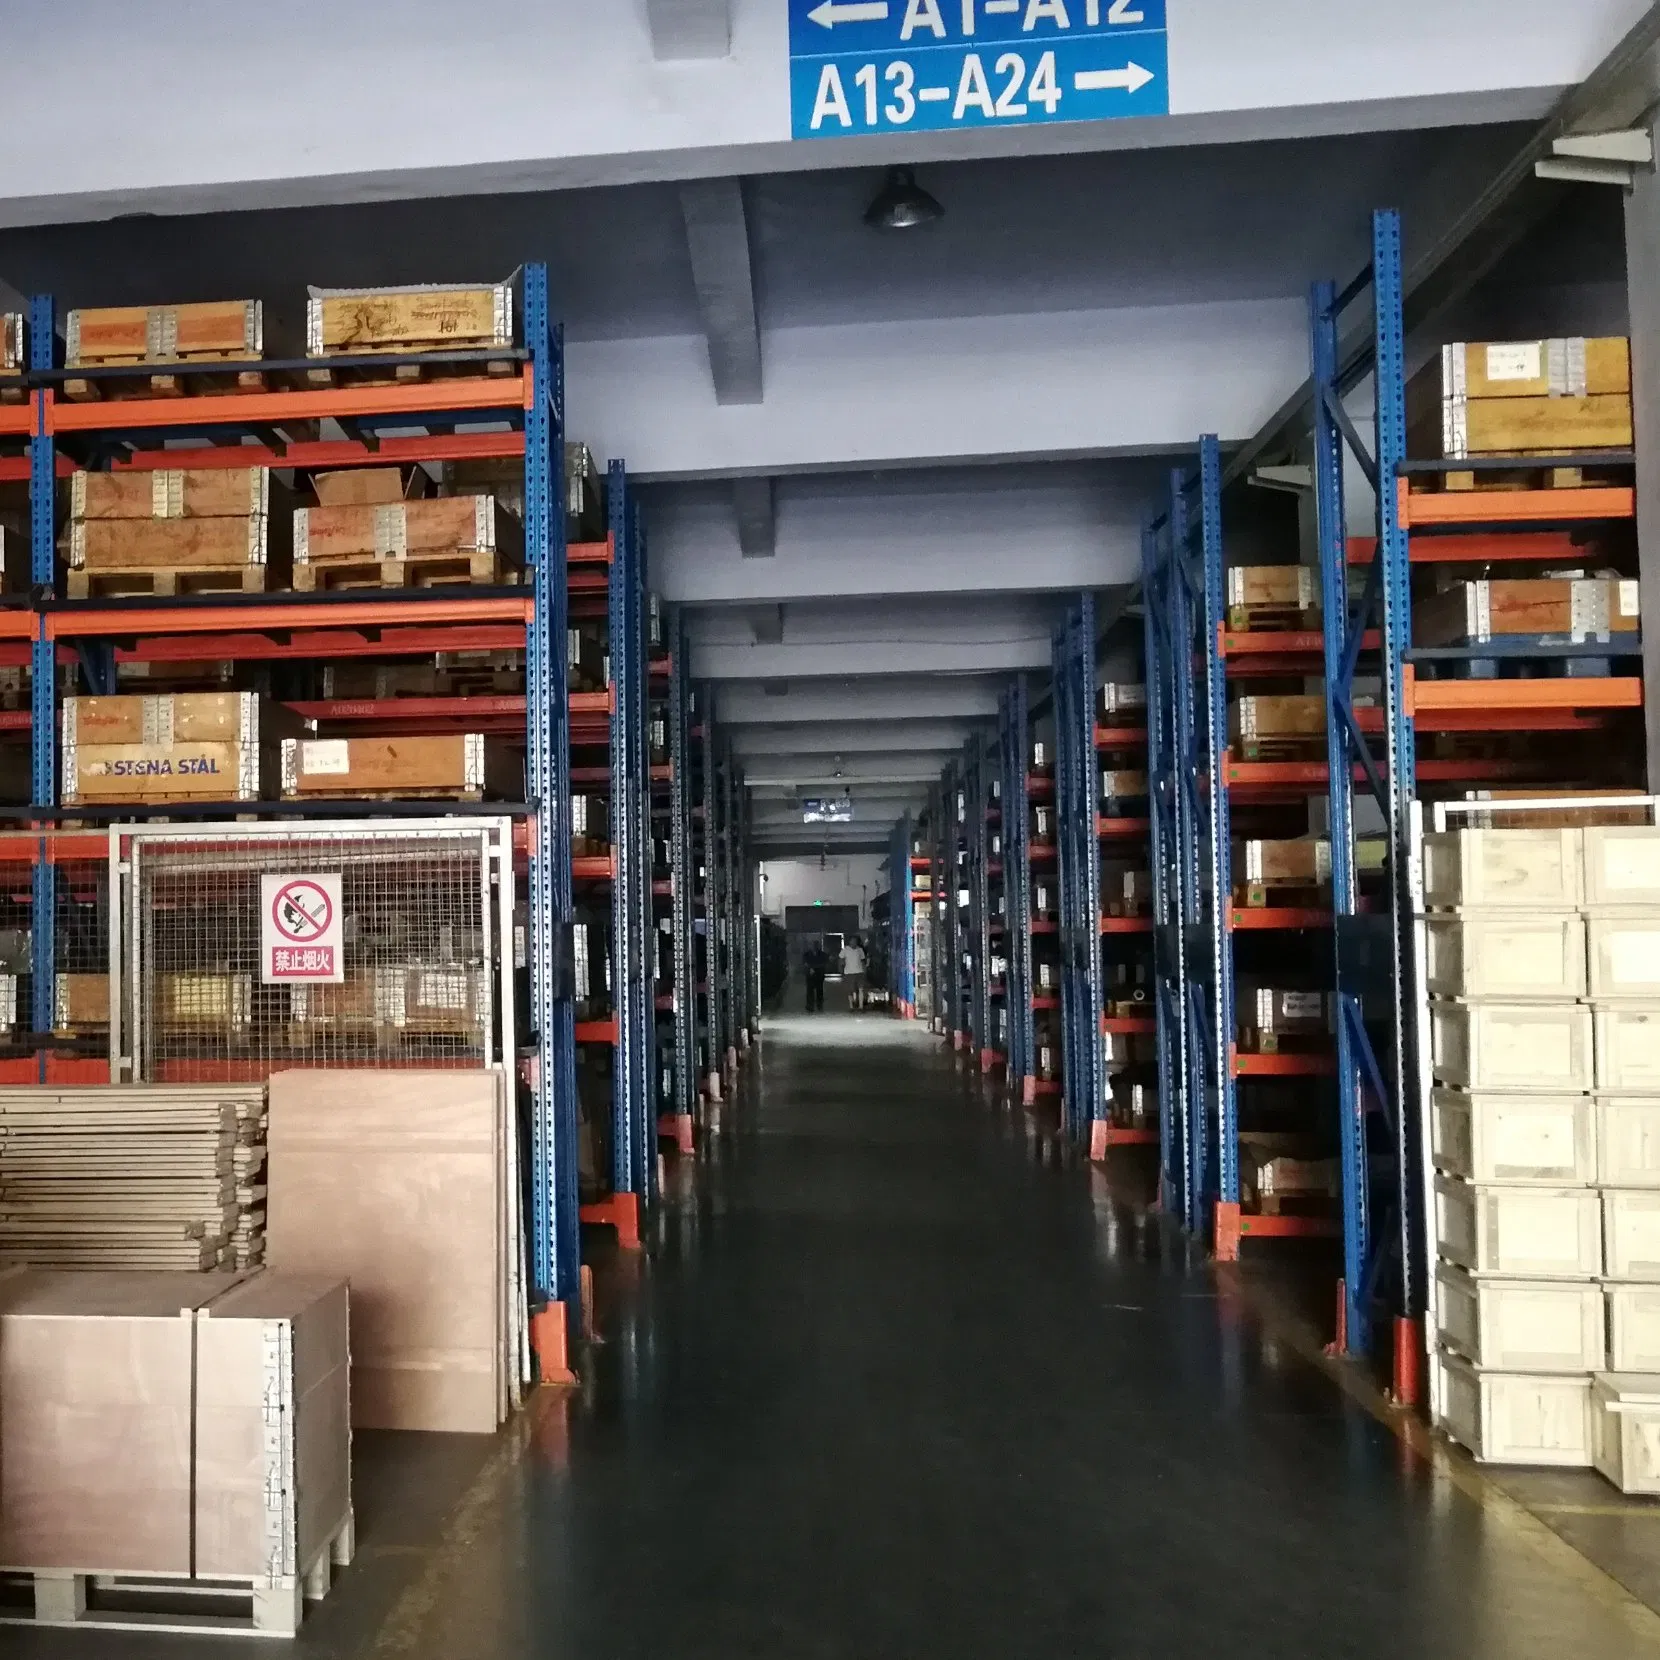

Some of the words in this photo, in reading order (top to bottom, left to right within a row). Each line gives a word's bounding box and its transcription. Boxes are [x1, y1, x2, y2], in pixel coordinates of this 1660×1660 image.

[810, 50, 1062, 130] A13-A24
[114, 758, 173, 776] STENA
[178, 753, 220, 775] STÅL
[275, 949, 331, 972] 禁止烟火
